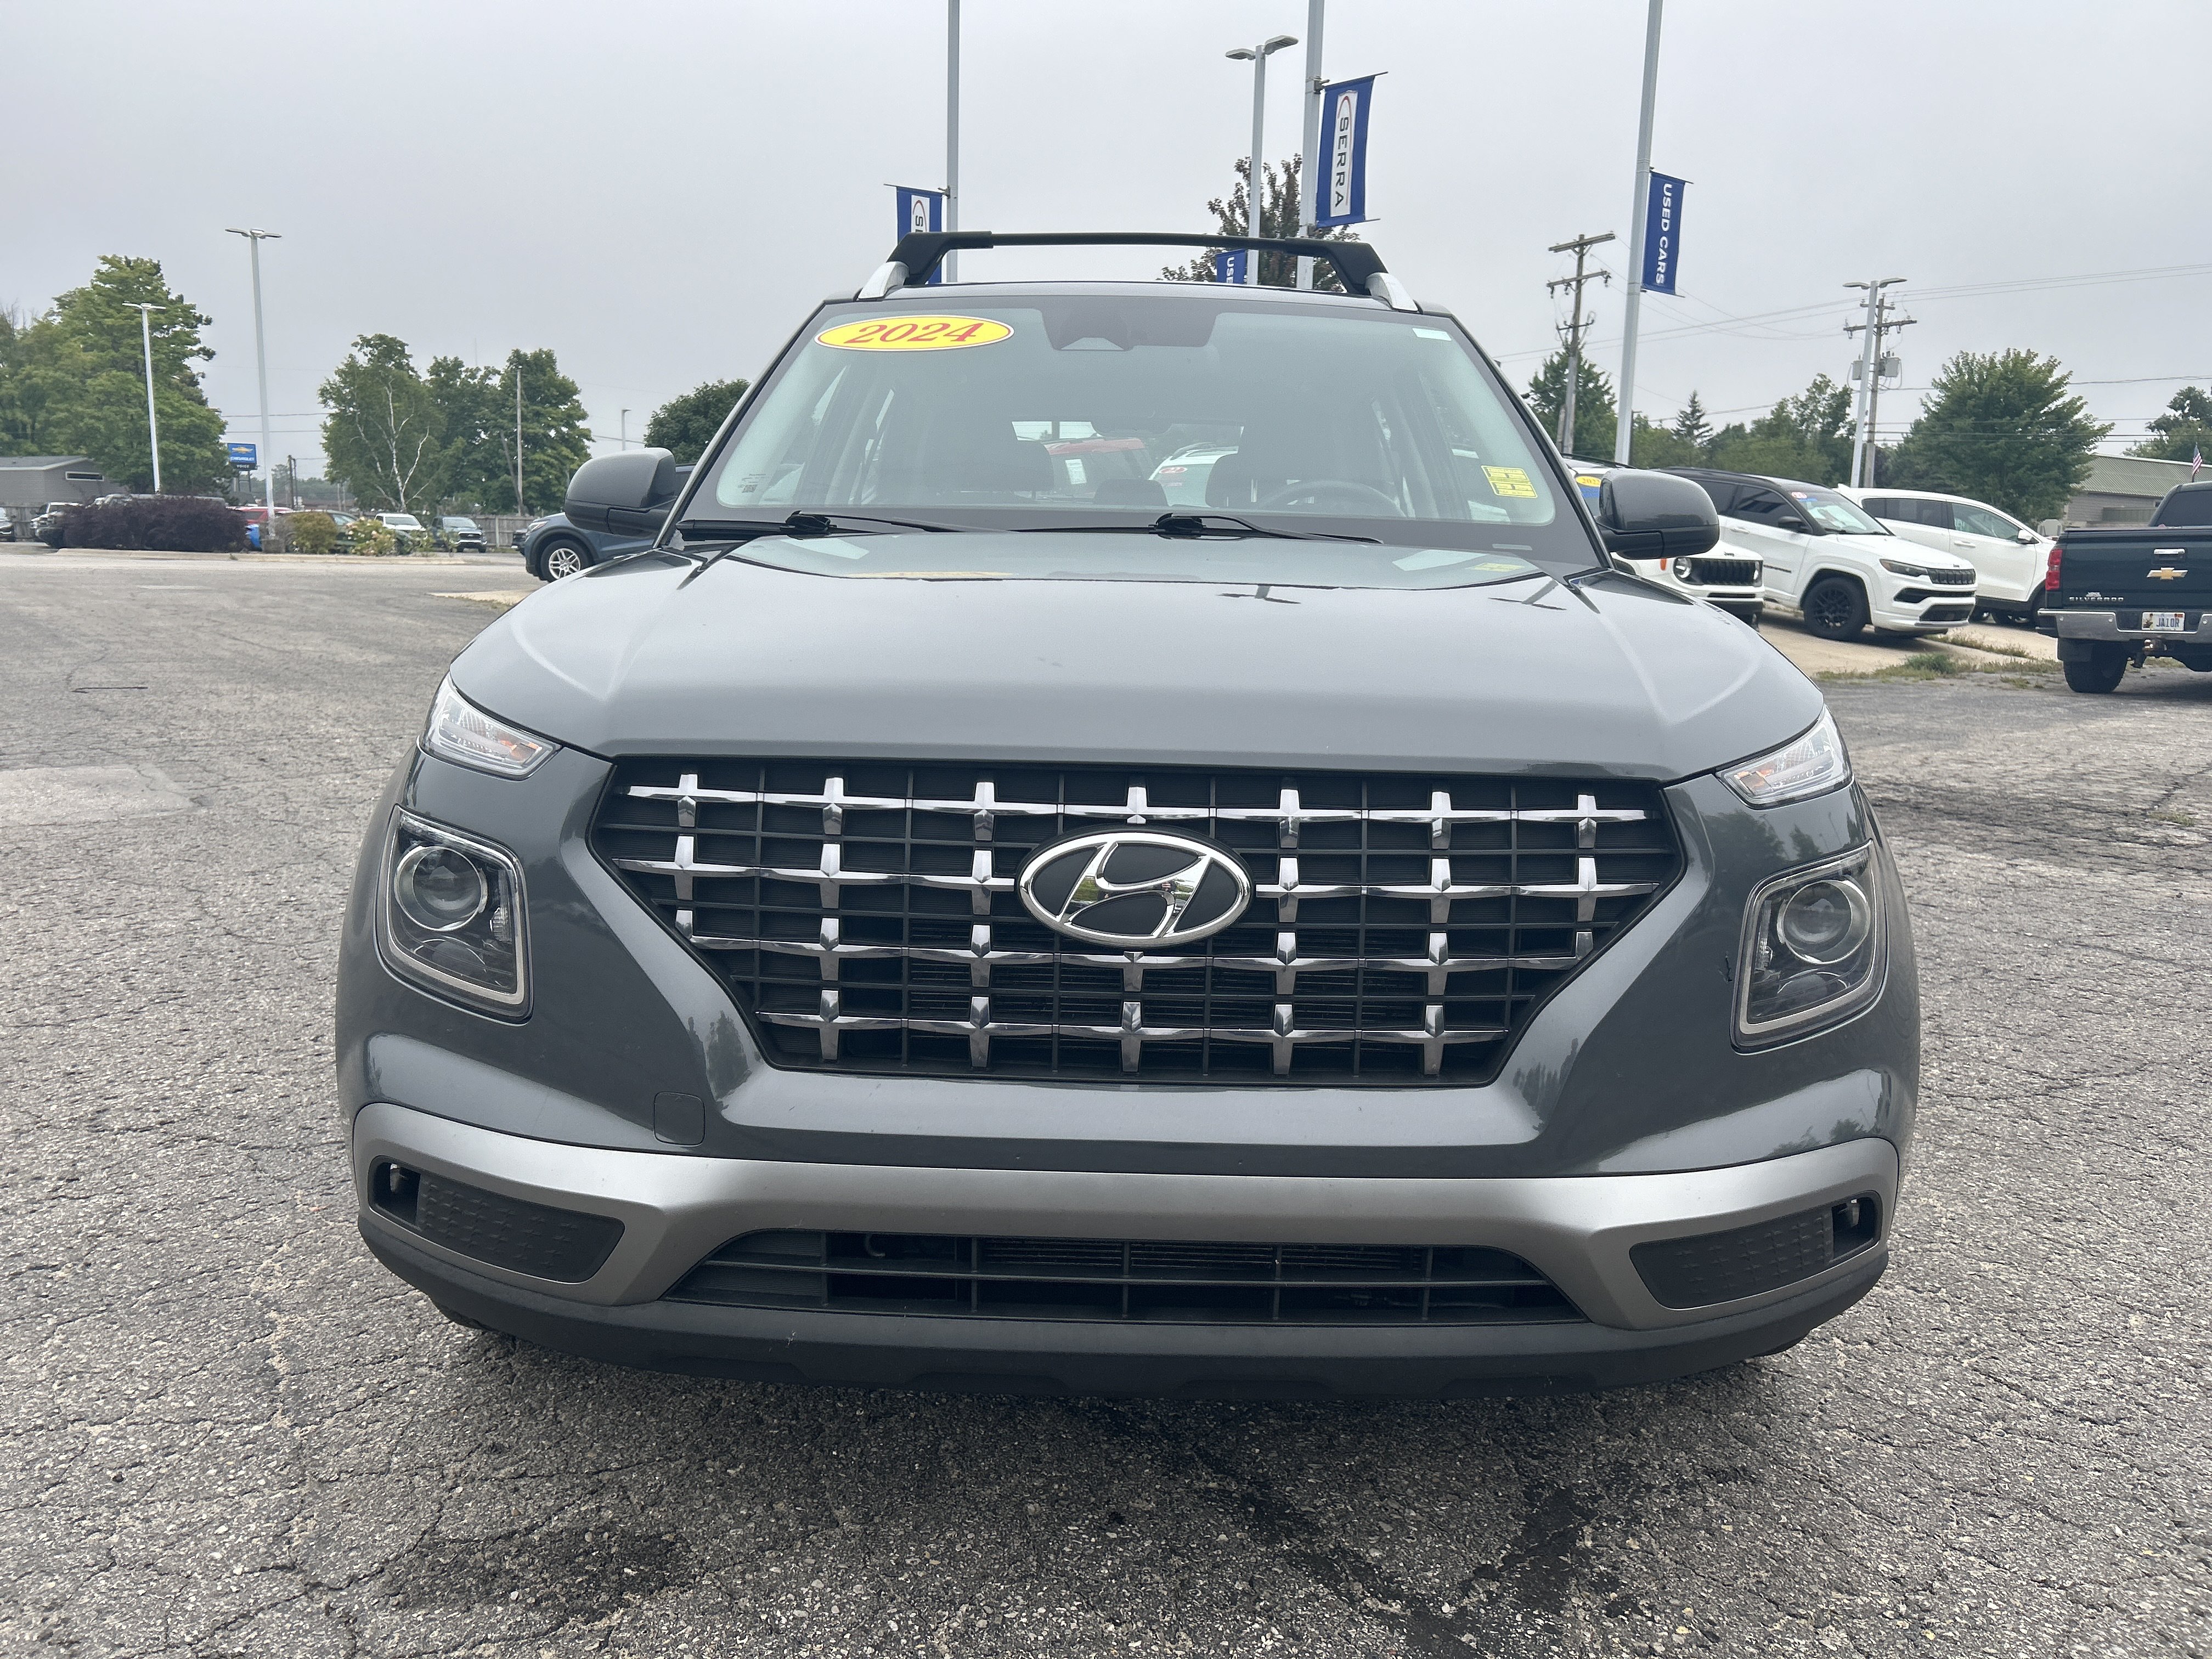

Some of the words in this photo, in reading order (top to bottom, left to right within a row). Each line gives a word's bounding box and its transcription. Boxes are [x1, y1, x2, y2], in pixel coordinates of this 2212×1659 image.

[1335, 116, 1349, 207] SERRA
[1661, 183, 1673, 232] USED
[1655, 235, 1668, 284] CARS
[843, 323, 984, 344] 2024
